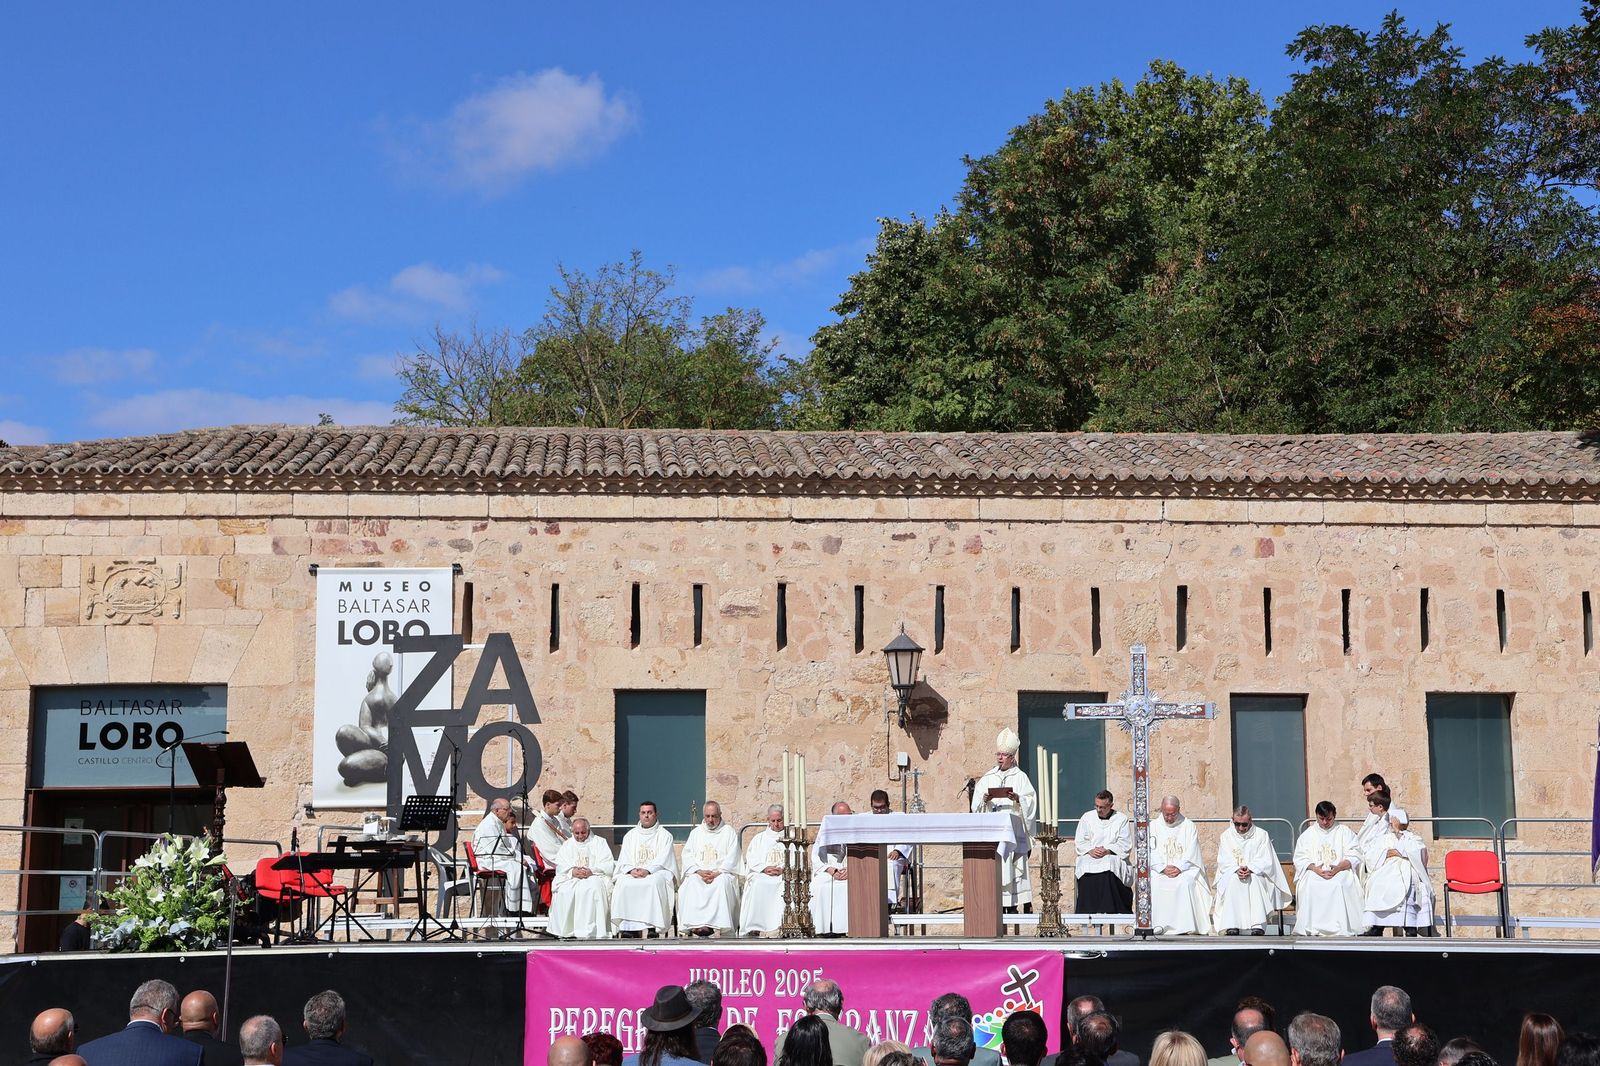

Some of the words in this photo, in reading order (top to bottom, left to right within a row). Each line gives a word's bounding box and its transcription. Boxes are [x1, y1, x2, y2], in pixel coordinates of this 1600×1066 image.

[339, 581, 431, 592] MUSEO
[338, 599, 431, 613] BALTASAR
[338, 619, 431, 646] LOBO
[80, 699, 183, 716] BALTASAR
[79, 721, 184, 750] LOBO
[78, 757, 119, 765] CASTILLO
[121, 757, 153, 765] CENTRO
[774, 967, 824, 998] 2025
